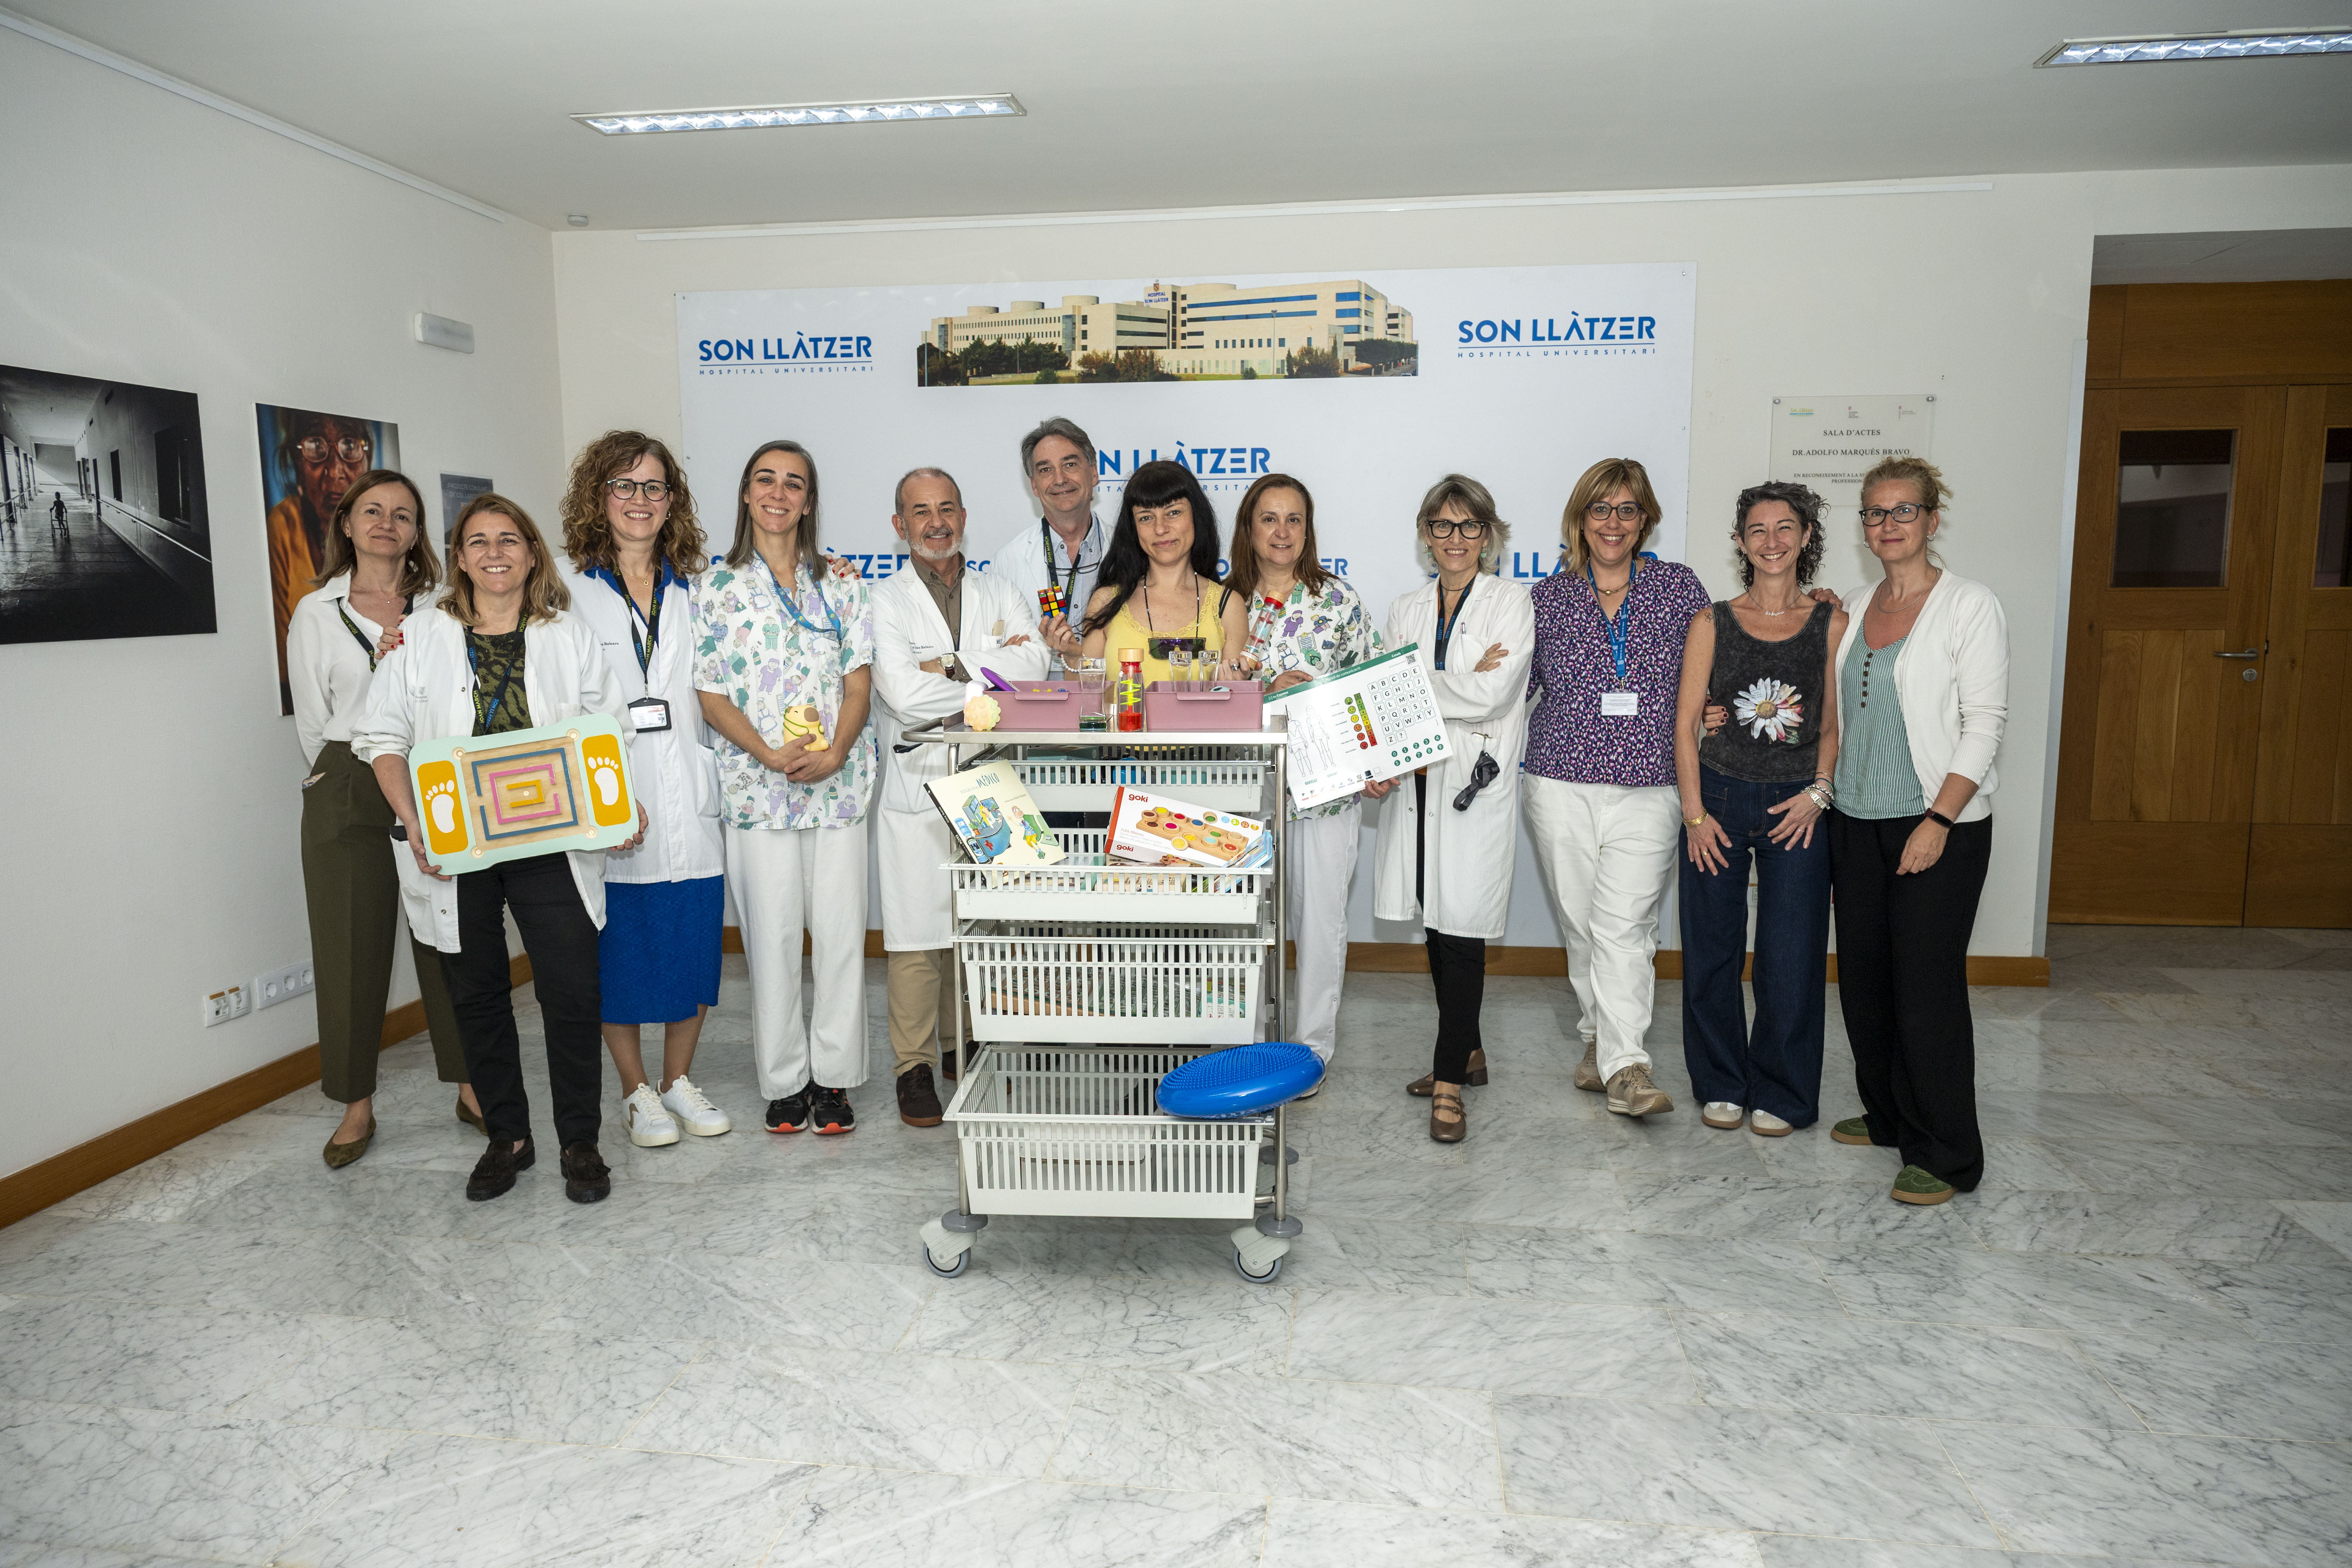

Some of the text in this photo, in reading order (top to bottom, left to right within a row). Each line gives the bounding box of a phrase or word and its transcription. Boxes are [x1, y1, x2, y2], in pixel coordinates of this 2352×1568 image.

[1458, 311, 1656, 343] SON LLÀTZER
[699, 331, 872, 361] SON LLÀTZER
[1841, 448, 1880, 457] MARQUÉS
[348, 623, 358, 634] JOAN
[1340, 666, 1361, 677] comunicació
[1129, 794, 1148, 802] goki
